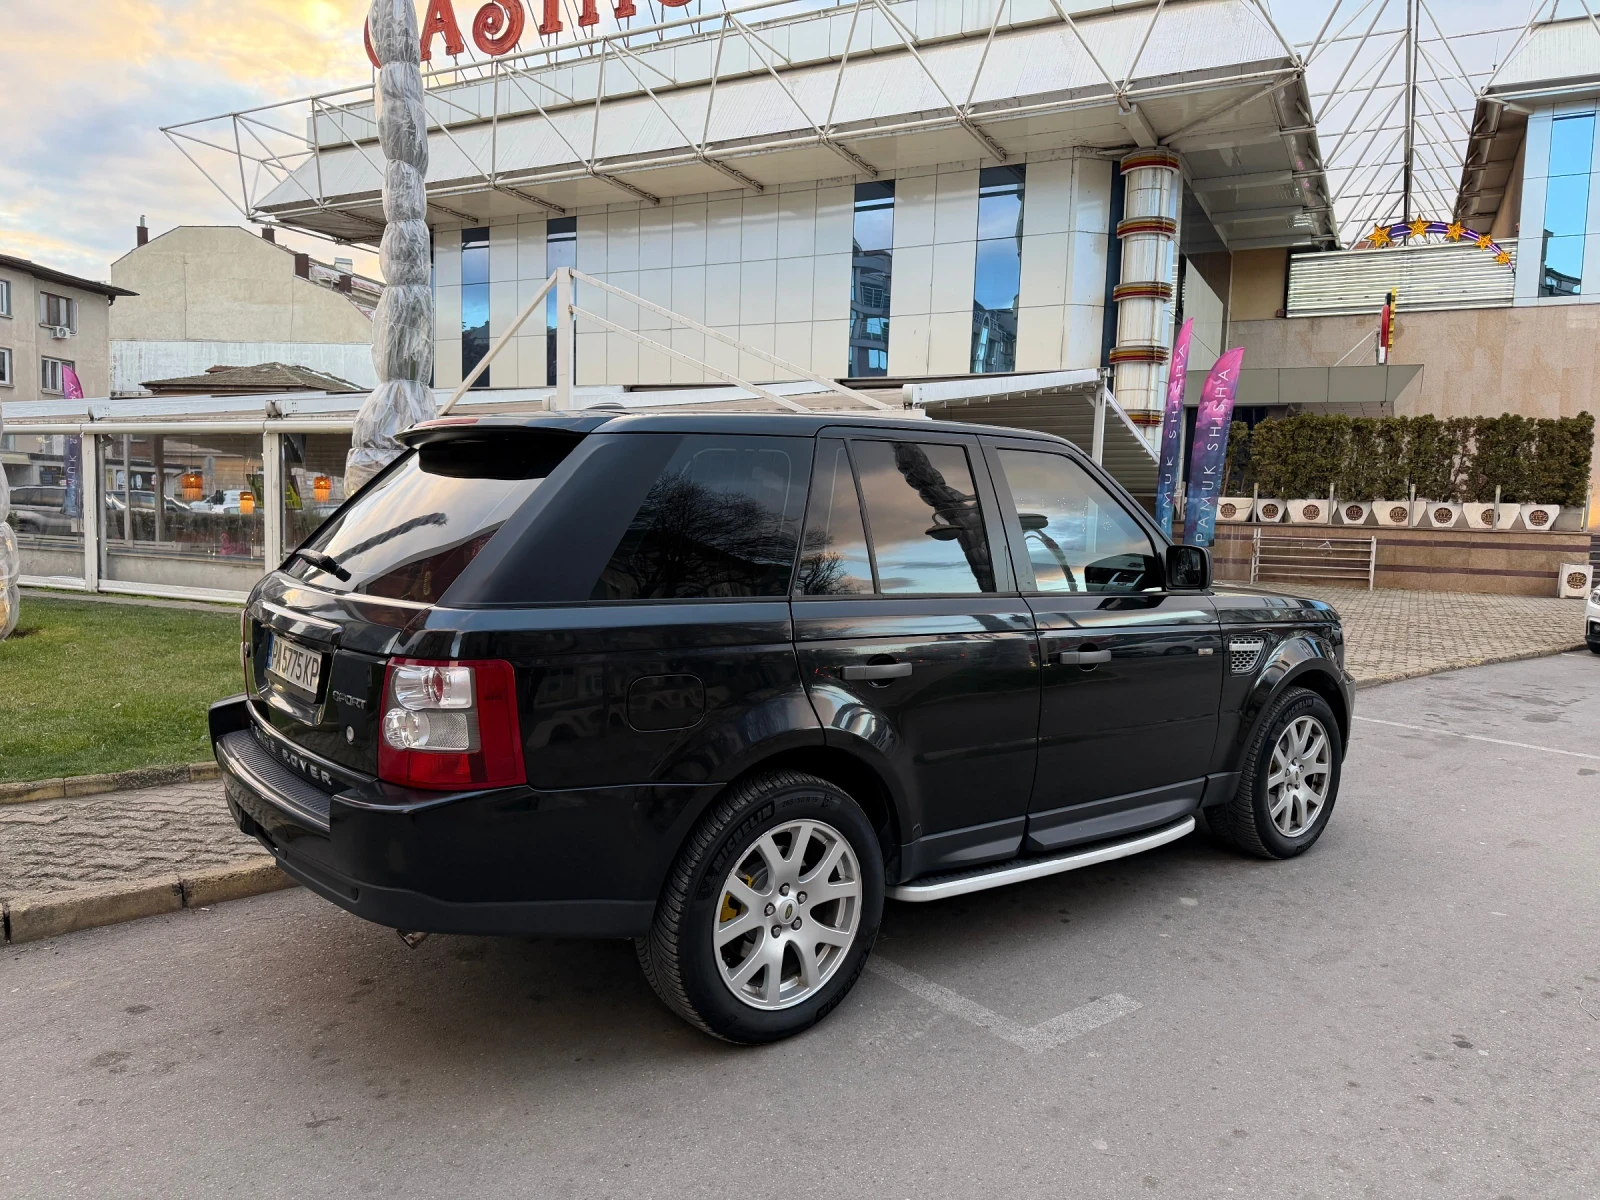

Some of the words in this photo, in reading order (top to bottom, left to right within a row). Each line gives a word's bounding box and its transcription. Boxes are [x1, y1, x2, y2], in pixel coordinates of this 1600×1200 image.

[1168, 343, 1186, 439] SHISHA
[1195, 465, 1217, 542] PAMUK
[1206, 368, 1231, 451] SHISHA
[332, 690, 367, 709] SPORT
[282, 748, 332, 785] ROVER
[712, 804, 775, 872] MICHELIN
